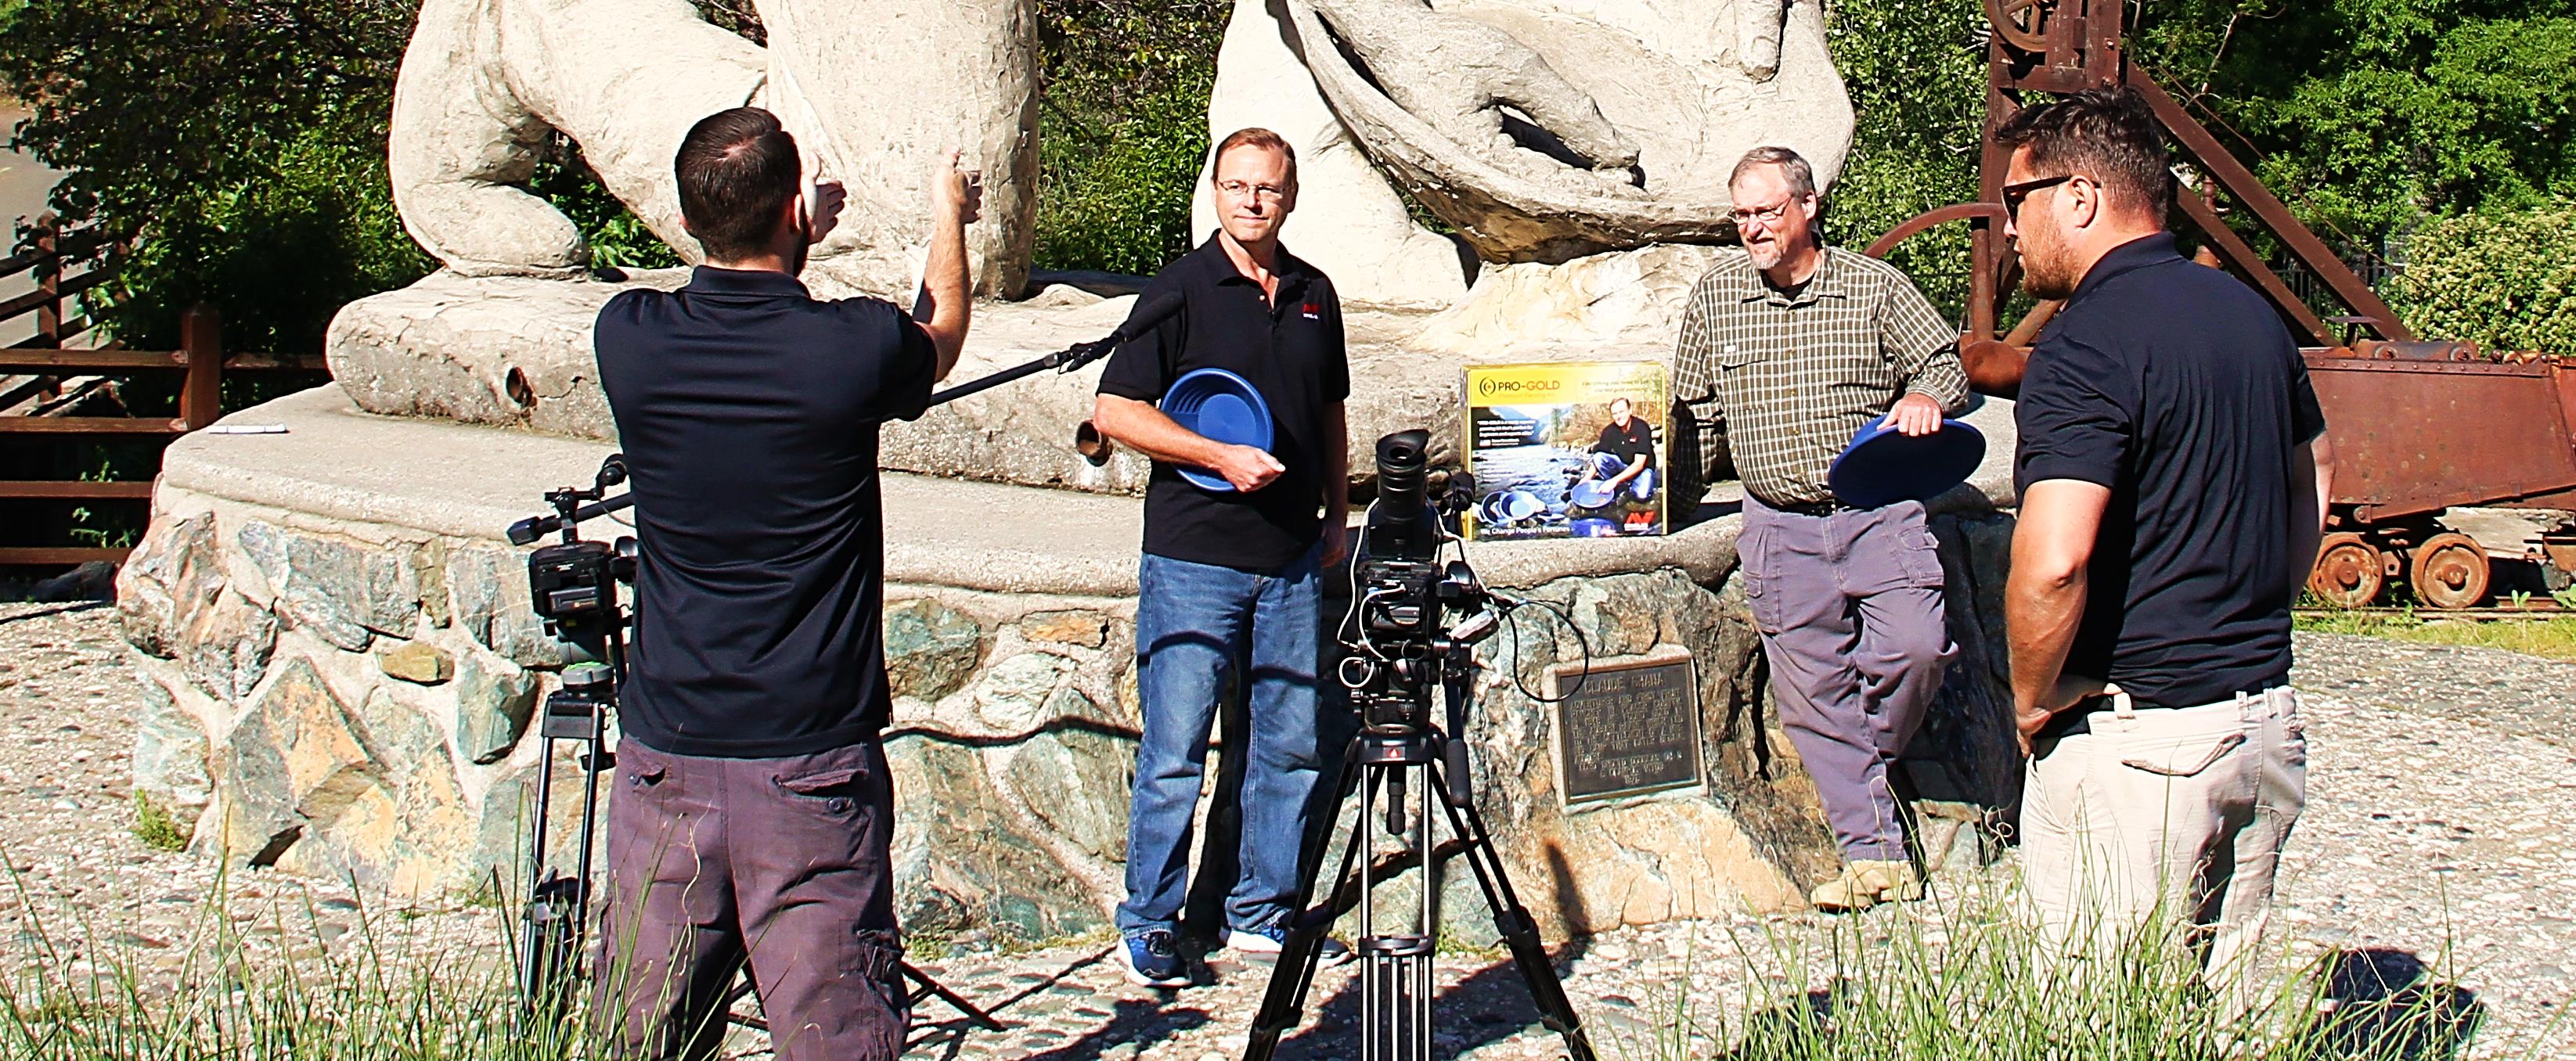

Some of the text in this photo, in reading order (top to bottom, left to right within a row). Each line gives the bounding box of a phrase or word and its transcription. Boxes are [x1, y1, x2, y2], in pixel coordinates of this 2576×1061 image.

[1498, 380, 1560, 391] PRO-GOLD
[1491, 527, 1515, 536] Change
[1515, 526, 1542, 535] People's
[1585, 678, 1626, 694] CLAUDE
